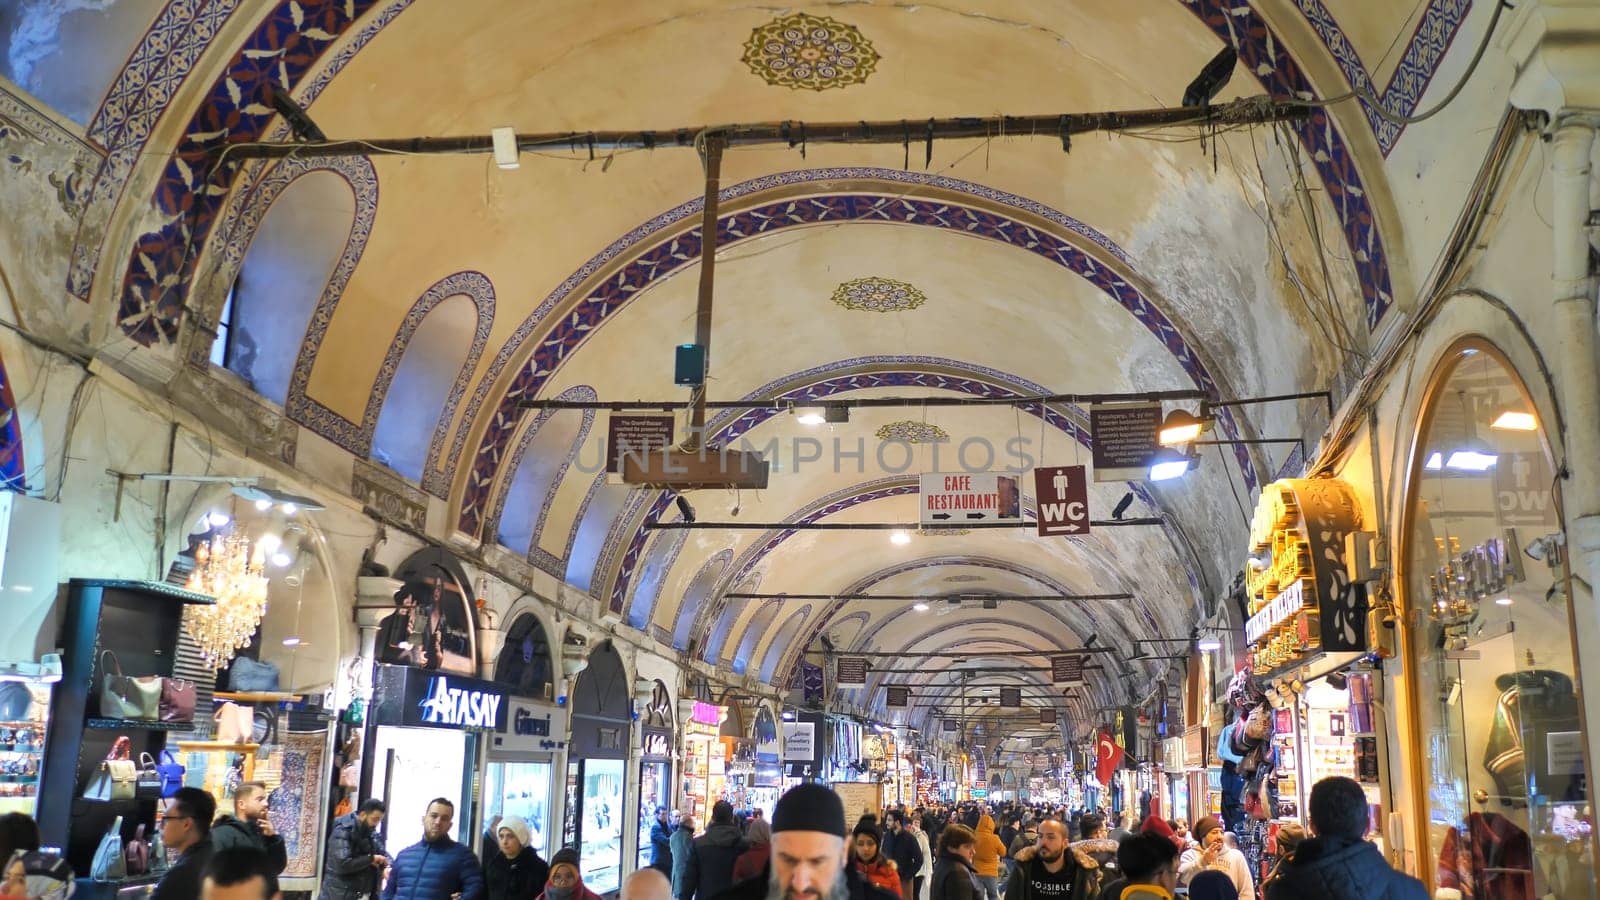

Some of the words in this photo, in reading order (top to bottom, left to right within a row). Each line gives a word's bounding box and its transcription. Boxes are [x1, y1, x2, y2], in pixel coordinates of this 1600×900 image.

[944, 475, 970, 492] CAFE
[928, 494, 997, 510] RESTAURANT
[1040, 502, 1085, 523] WC
[418, 676, 501, 728] ATASAY
